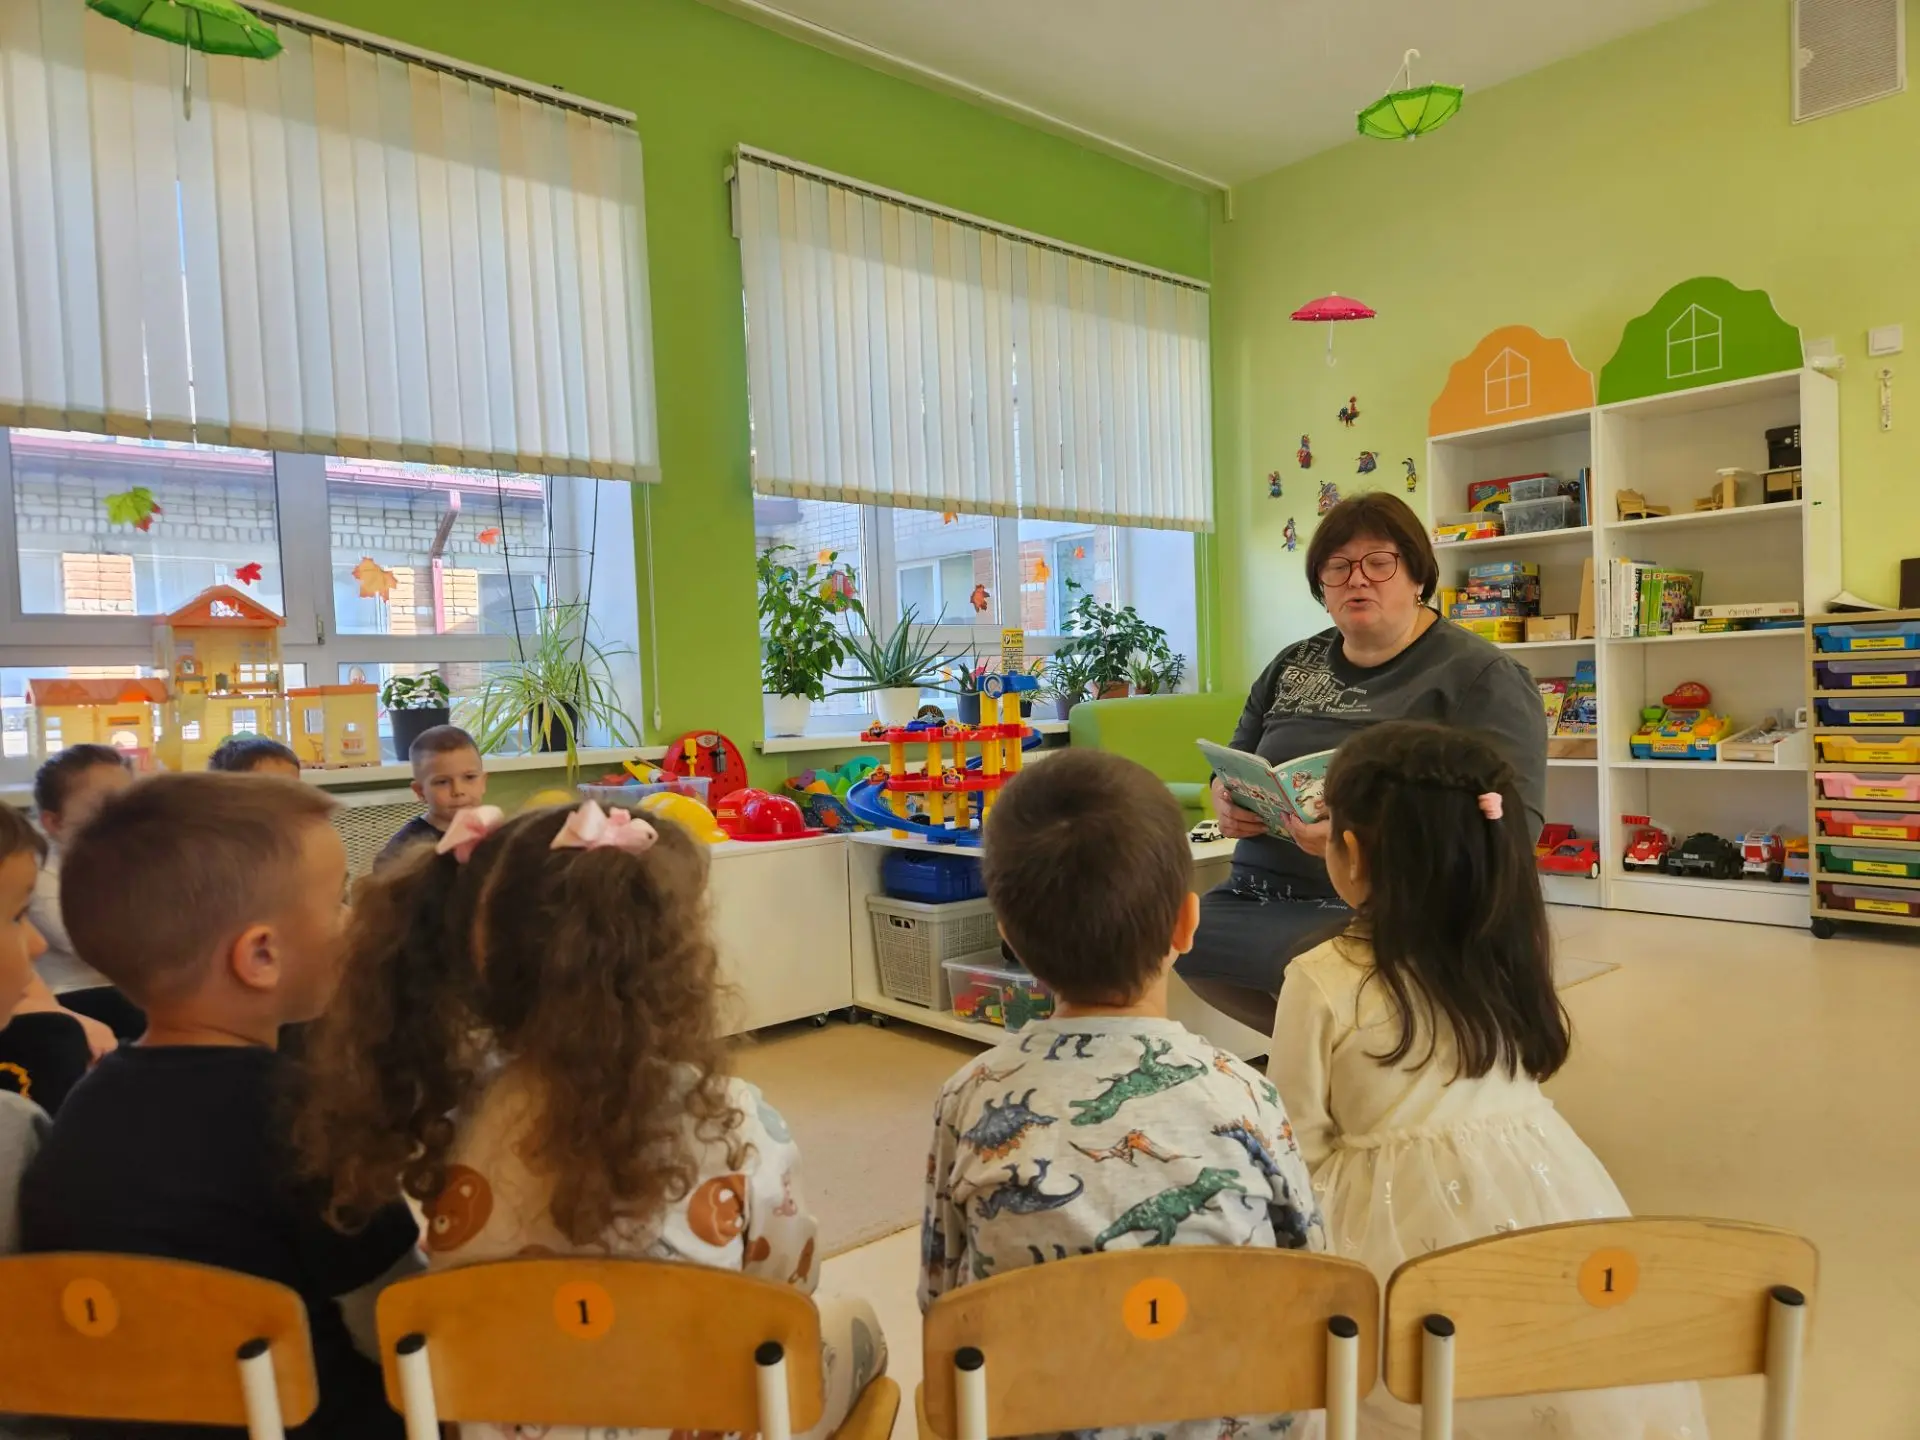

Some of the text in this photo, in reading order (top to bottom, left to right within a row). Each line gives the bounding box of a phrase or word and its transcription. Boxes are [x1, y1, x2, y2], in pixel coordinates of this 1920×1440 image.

[1602, 1267, 1614, 1292] 1
[84, 1297, 98, 1323] 1
[577, 1299, 591, 1325] 1
[1147, 1298, 1160, 1325] 1
